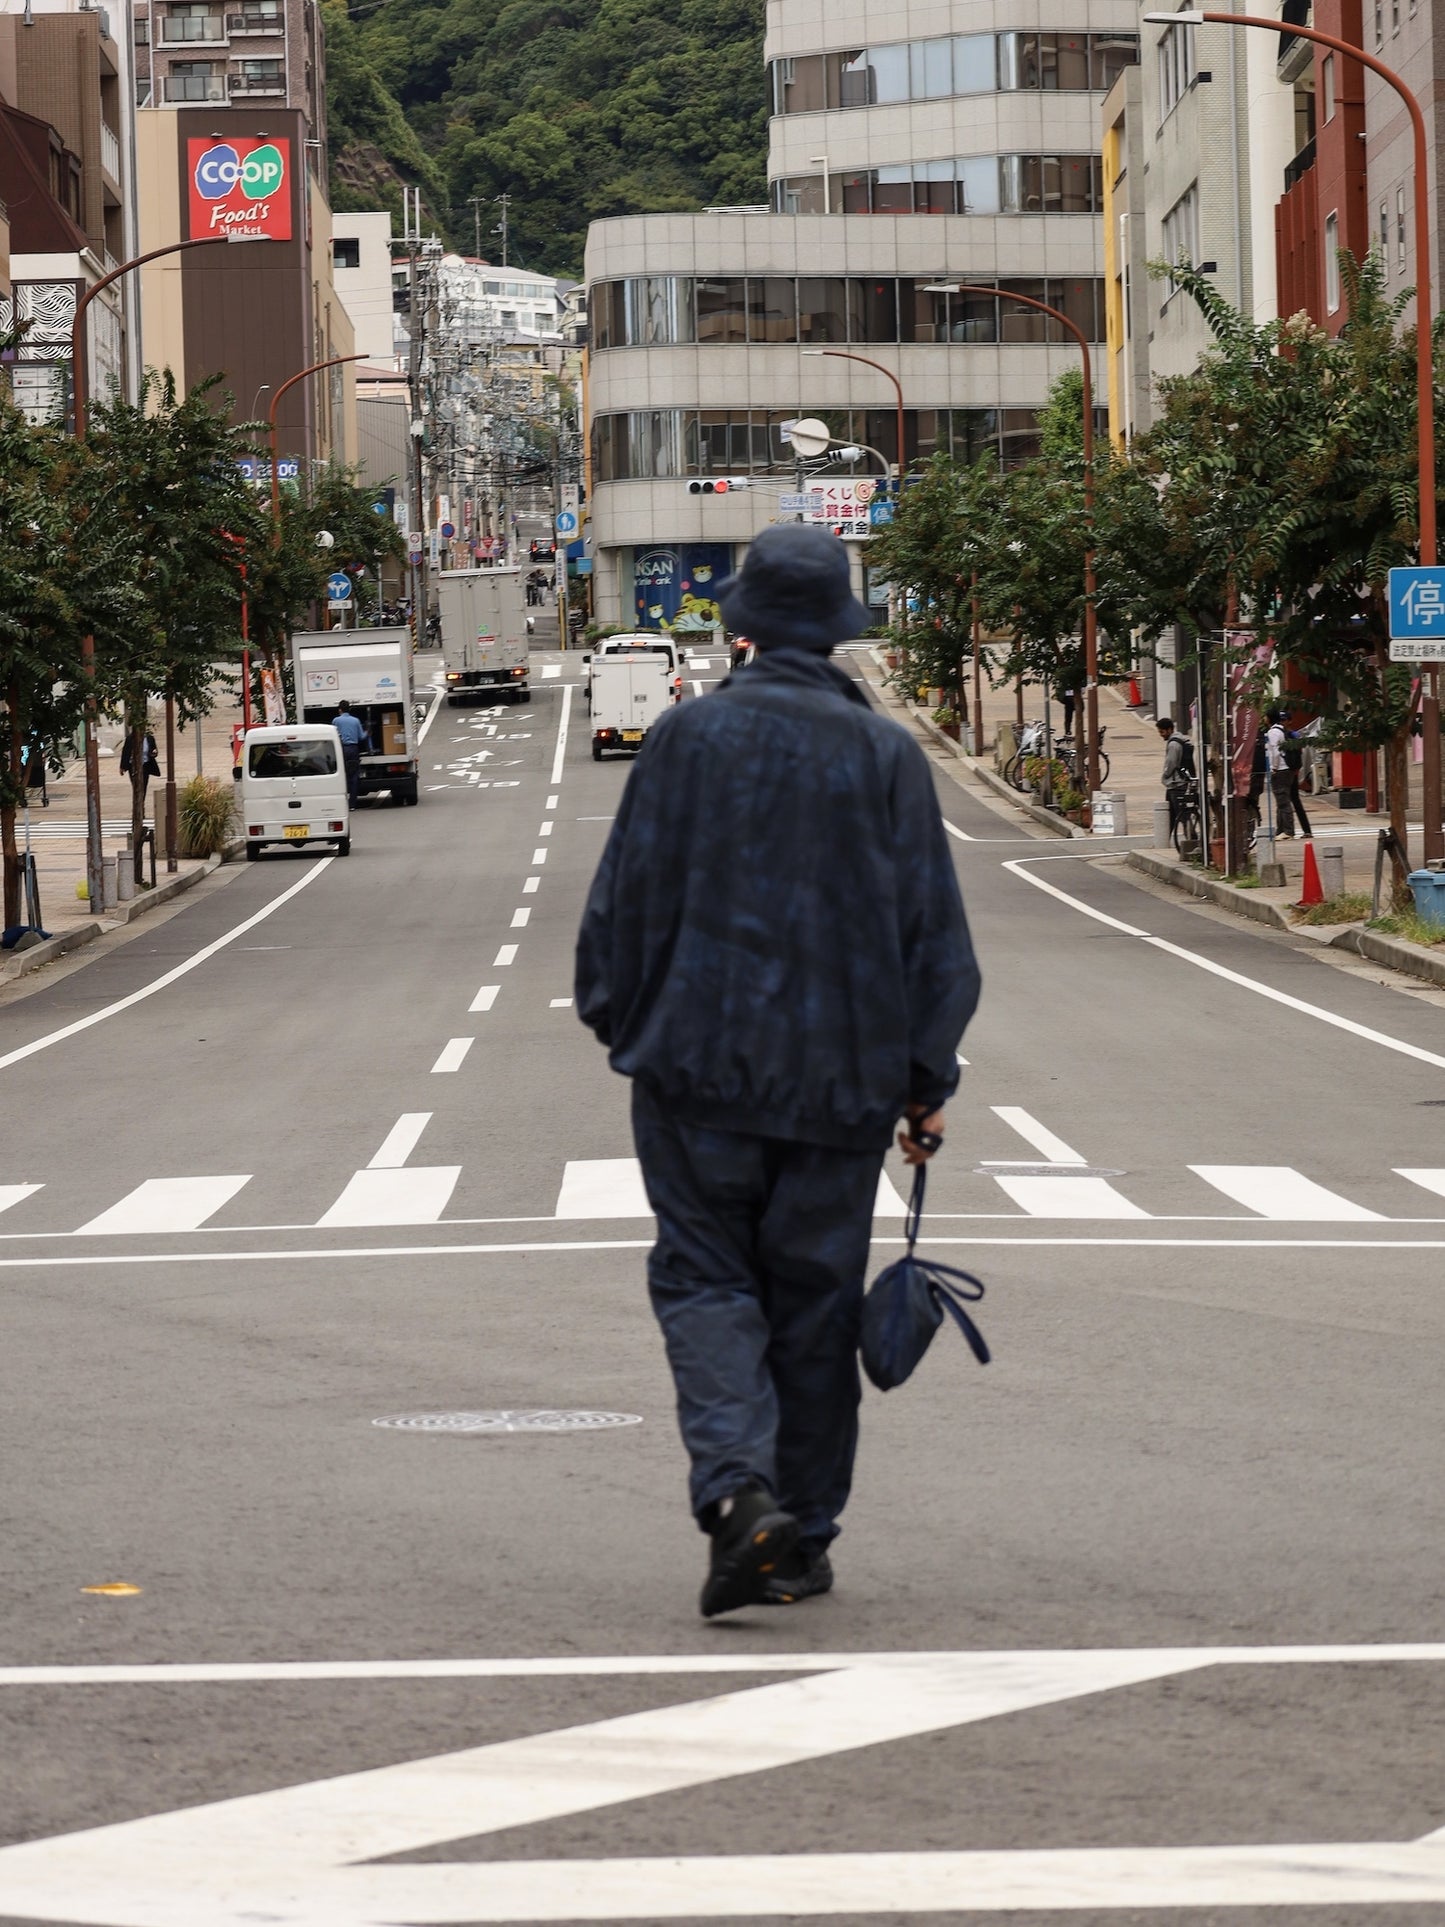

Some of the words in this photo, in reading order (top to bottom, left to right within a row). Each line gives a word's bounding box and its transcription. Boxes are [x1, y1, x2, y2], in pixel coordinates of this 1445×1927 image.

[209, 202, 270, 229] Food's
[219, 224, 263, 235] Market
[1400, 579, 1445, 626] 停
